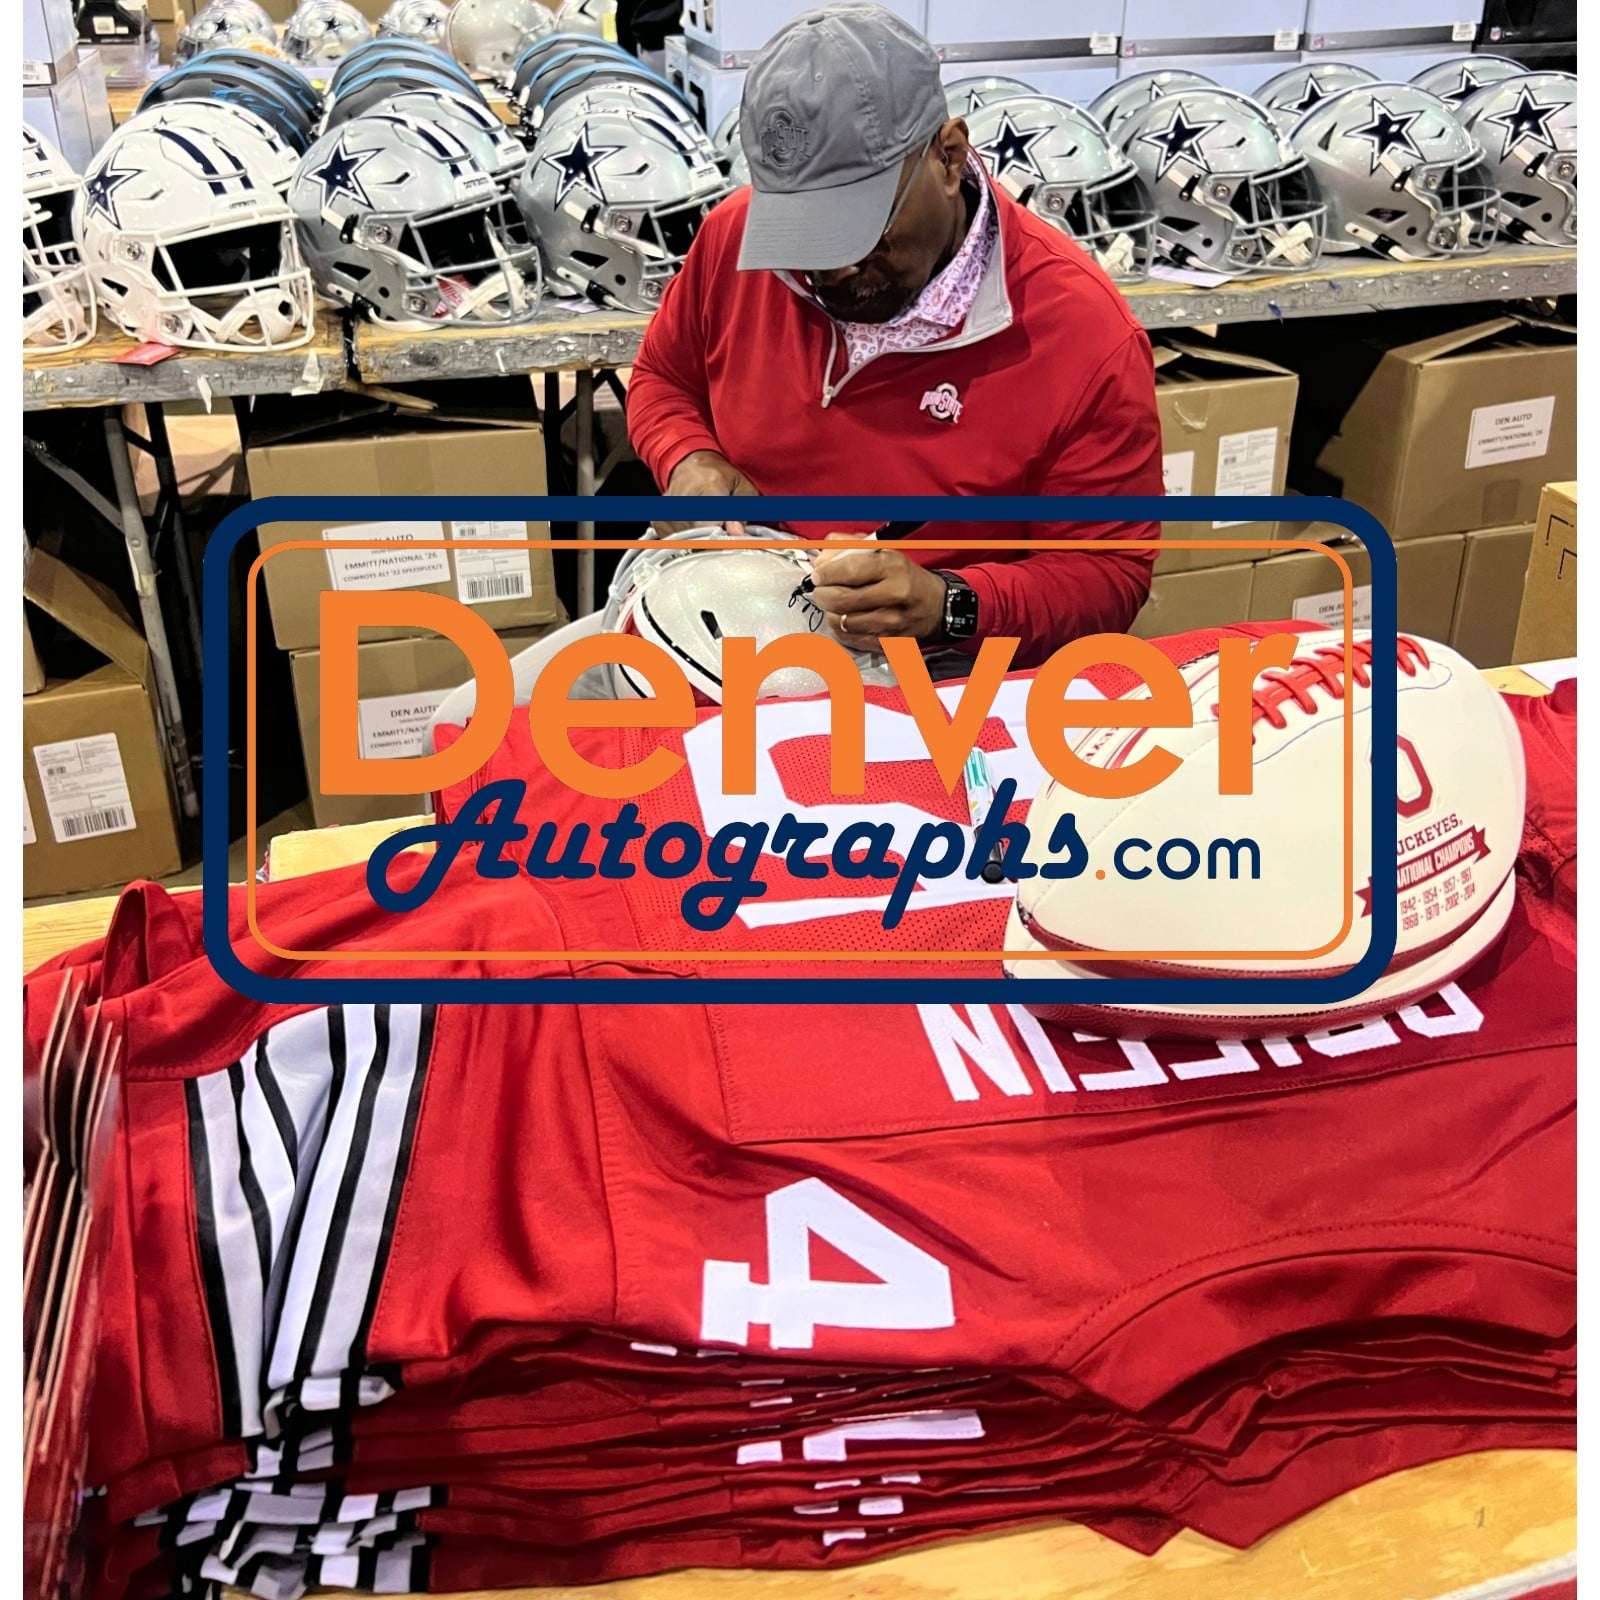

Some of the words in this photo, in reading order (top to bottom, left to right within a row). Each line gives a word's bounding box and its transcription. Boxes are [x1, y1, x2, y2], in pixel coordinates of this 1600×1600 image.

[1511, 412, 1533, 423] AUTO
[344, 554, 424, 571] EMMITT/NATIONAL
[390, 708, 411, 718] DEN
[1397, 812, 1460, 857] UCKEYES
[1397, 853, 1435, 890] ATIONAL
[1434, 831, 1475, 872] CHAMPIONS
[1400, 896, 1417, 915] 1942
